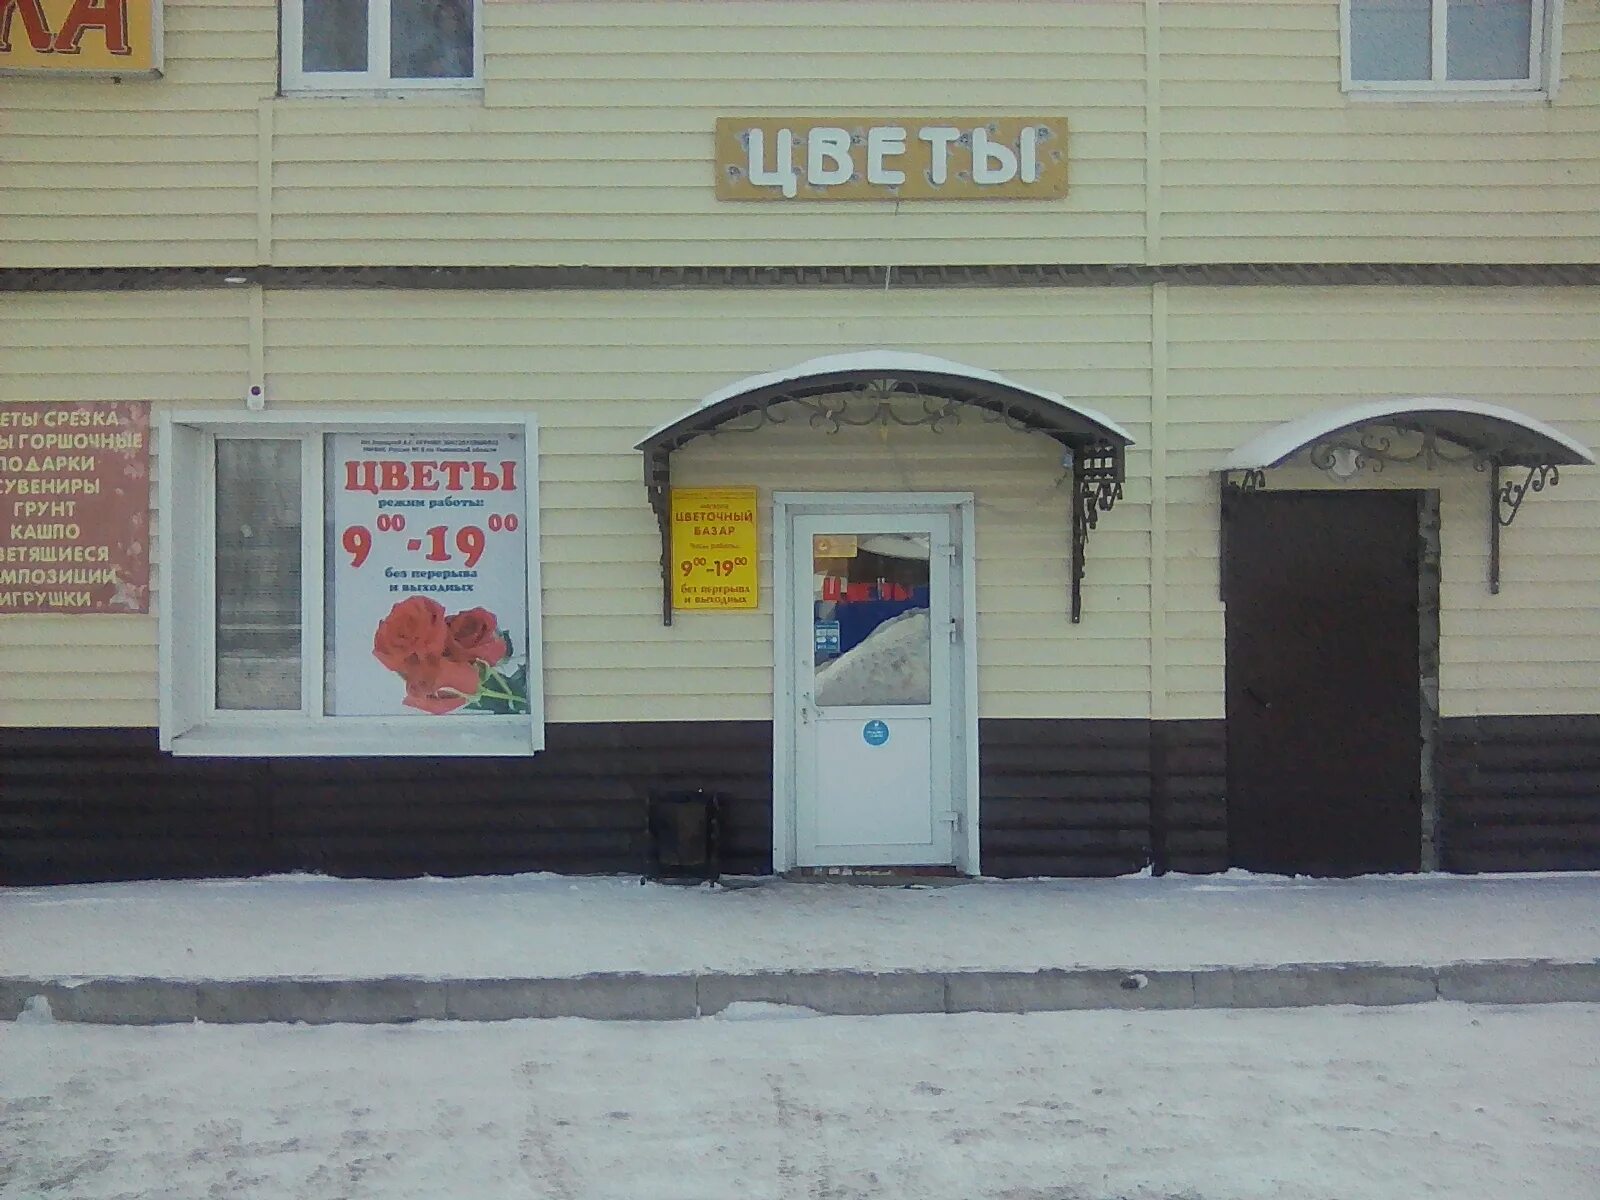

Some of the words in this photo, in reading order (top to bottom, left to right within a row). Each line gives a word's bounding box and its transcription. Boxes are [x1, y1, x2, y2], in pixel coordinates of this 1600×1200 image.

[749, 126, 1036, 198] ЦВЕТЫ
[44, 411, 119, 427] СРЕЗКА
[19, 433, 142, 450] ГОРШОЧНЫЕ
[0, 456, 95, 472] ПОДАРКИ
[345, 461, 517, 494] ЦВЕТЫ
[0, 478, 99, 495] УВЕНИРЫ
[13, 501, 76, 517] ГРУНТ
[378, 499, 425, 508] режим
[429, 497, 484, 508] работы:
[676, 510, 753, 522] ЦВЕТОЧНЫЙ
[10, 523, 80, 540] КАШПО
[694, 526, 736, 536] БАЗАР
[385, 567, 407, 578] без
[411, 570, 477, 579] перерыва
[402, 584, 474, 592] выходных
[0, 591, 91, 607] ИГРУШКИ
